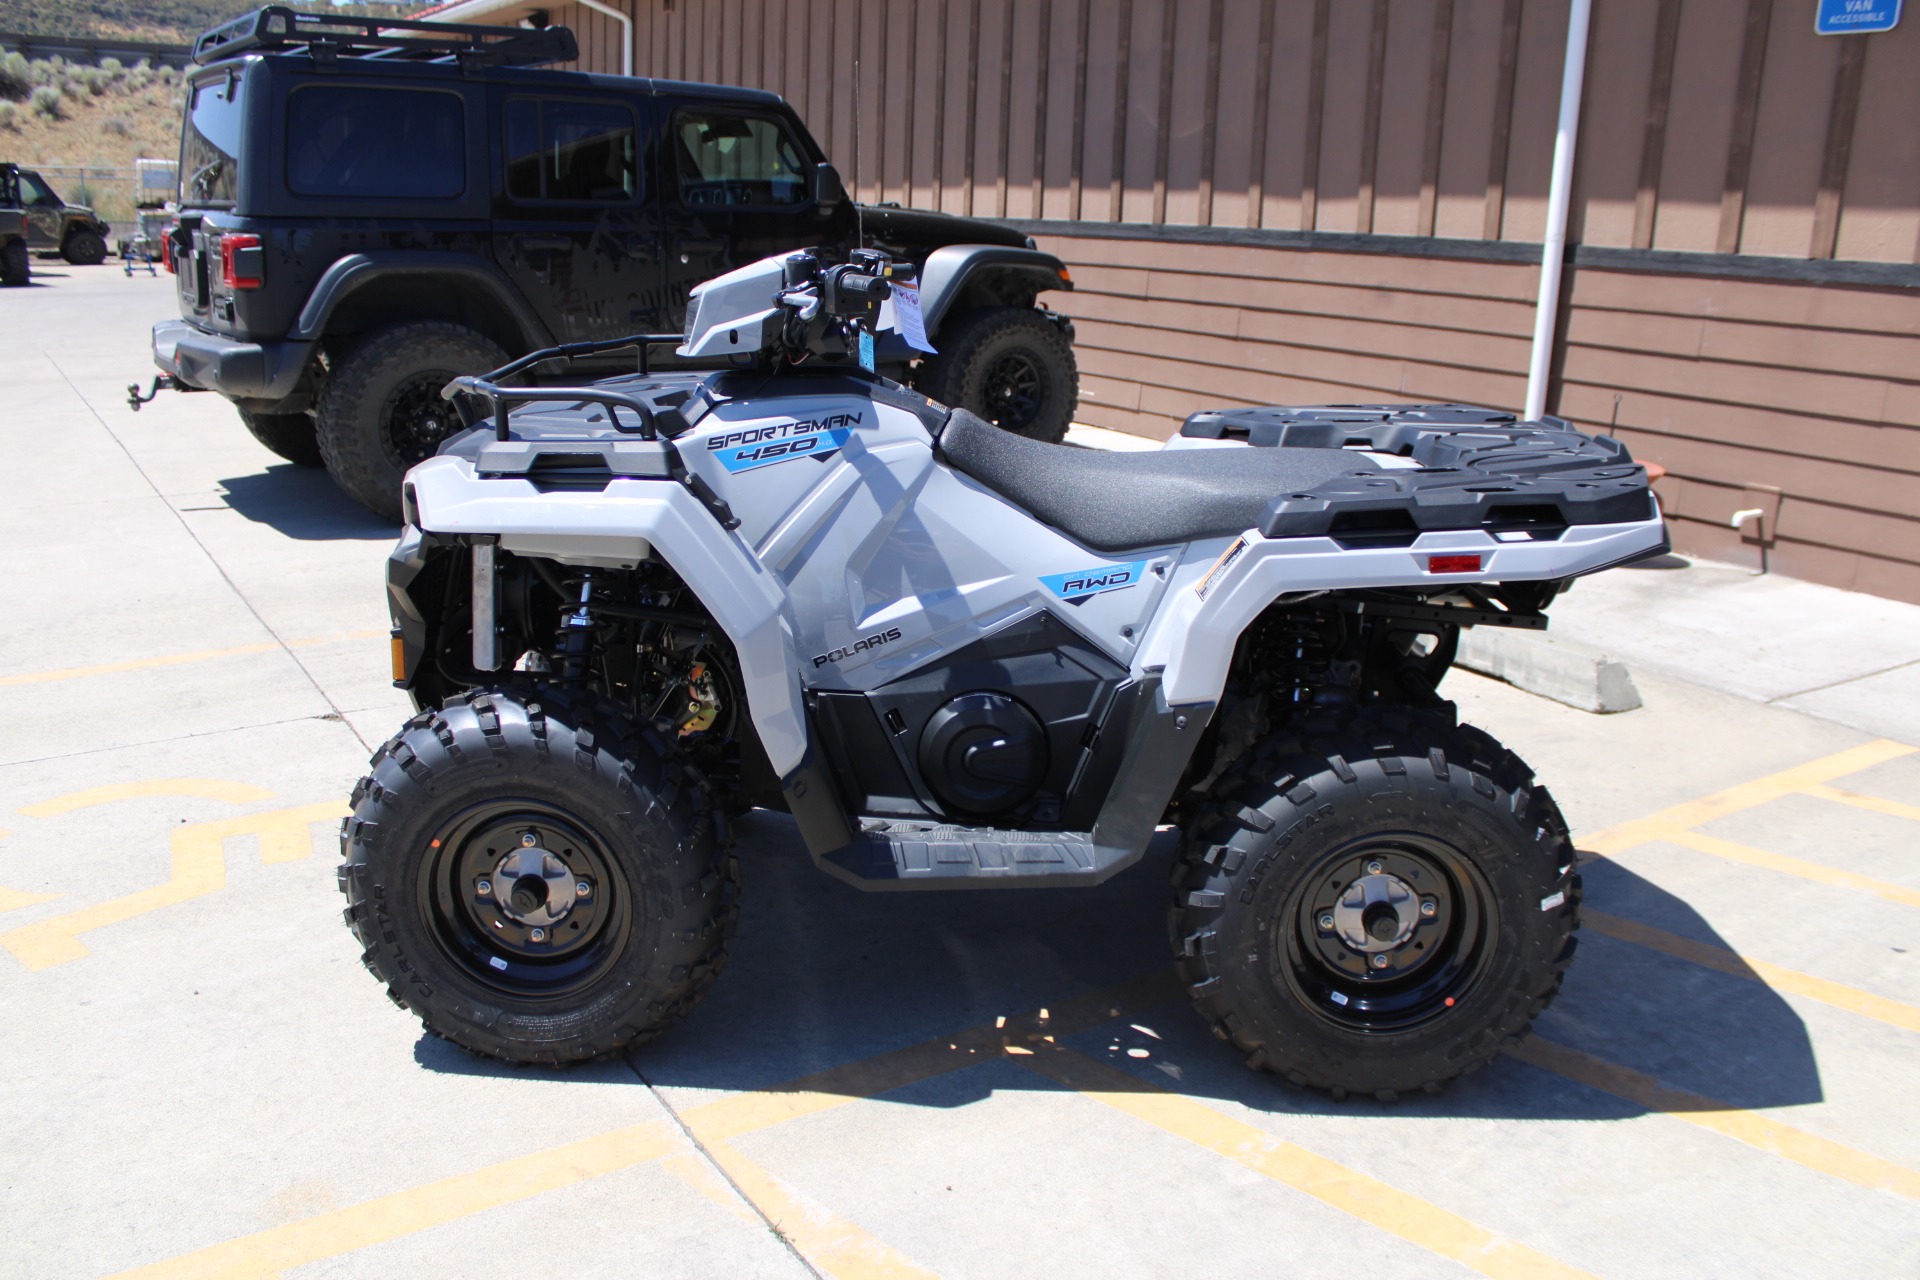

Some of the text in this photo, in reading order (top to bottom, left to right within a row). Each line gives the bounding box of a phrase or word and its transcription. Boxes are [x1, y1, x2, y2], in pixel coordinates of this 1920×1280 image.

[1828, 12, 1886, 24] ACCESSIBLE
[1845, 0, 1873, 12] VAN
[707, 412, 863, 450] SPORTSMAN
[735, 437, 818, 461] 450
[1062, 571, 1131, 593] AWD
[812, 627, 902, 668] POLARIS
[1240, 802, 1335, 905] CARLSTAR
[375, 884, 433, 997] CARLSTAR
